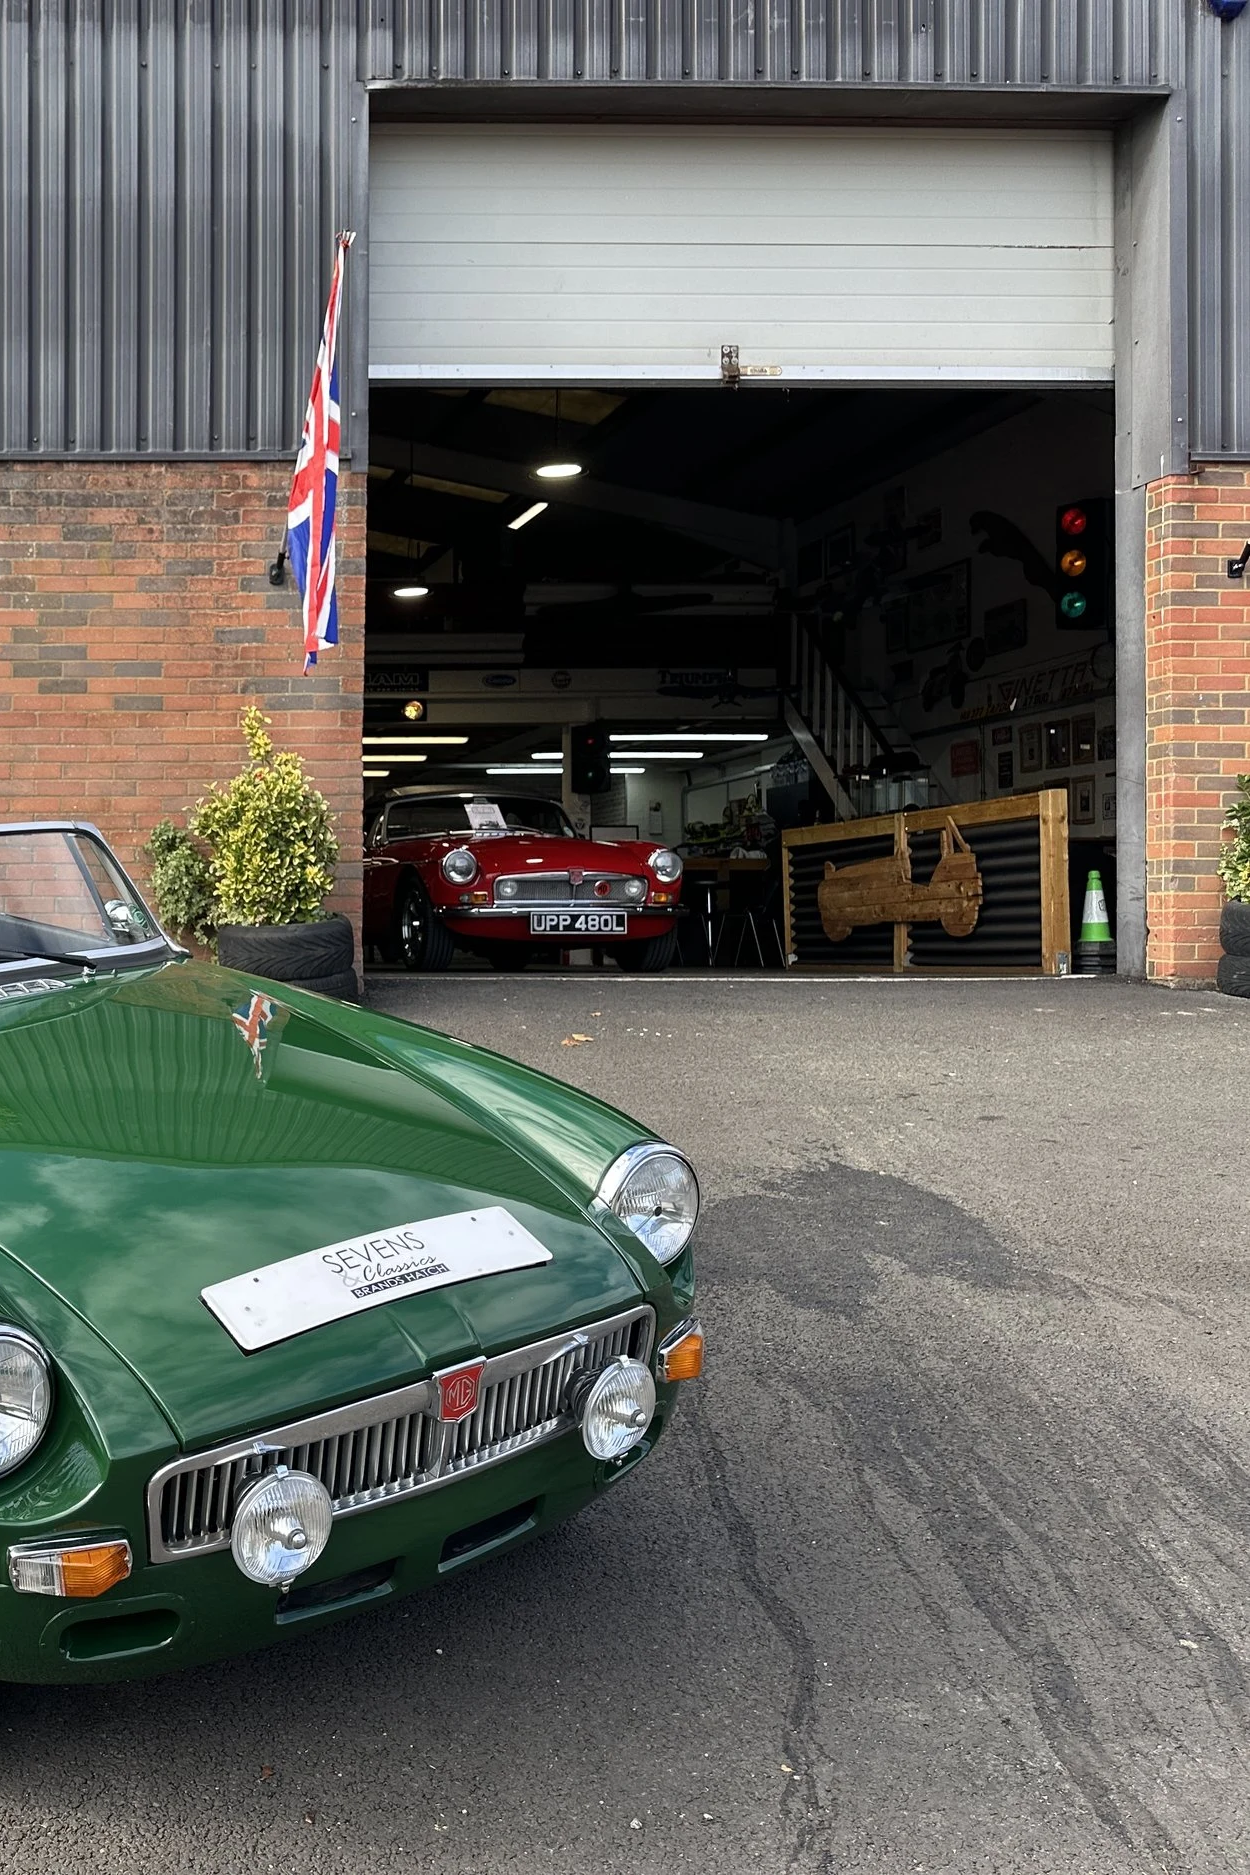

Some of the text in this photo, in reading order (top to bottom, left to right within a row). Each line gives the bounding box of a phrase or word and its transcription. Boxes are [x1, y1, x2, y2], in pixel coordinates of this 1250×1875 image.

[533, 915, 625, 931] UPP 480L
[322, 1231, 425, 1274] SEVENS
[353, 1263, 448, 1298] BRANDS HATCH
[363, 1255, 437, 1282] Classics
[448, 1378, 473, 1408] MG
